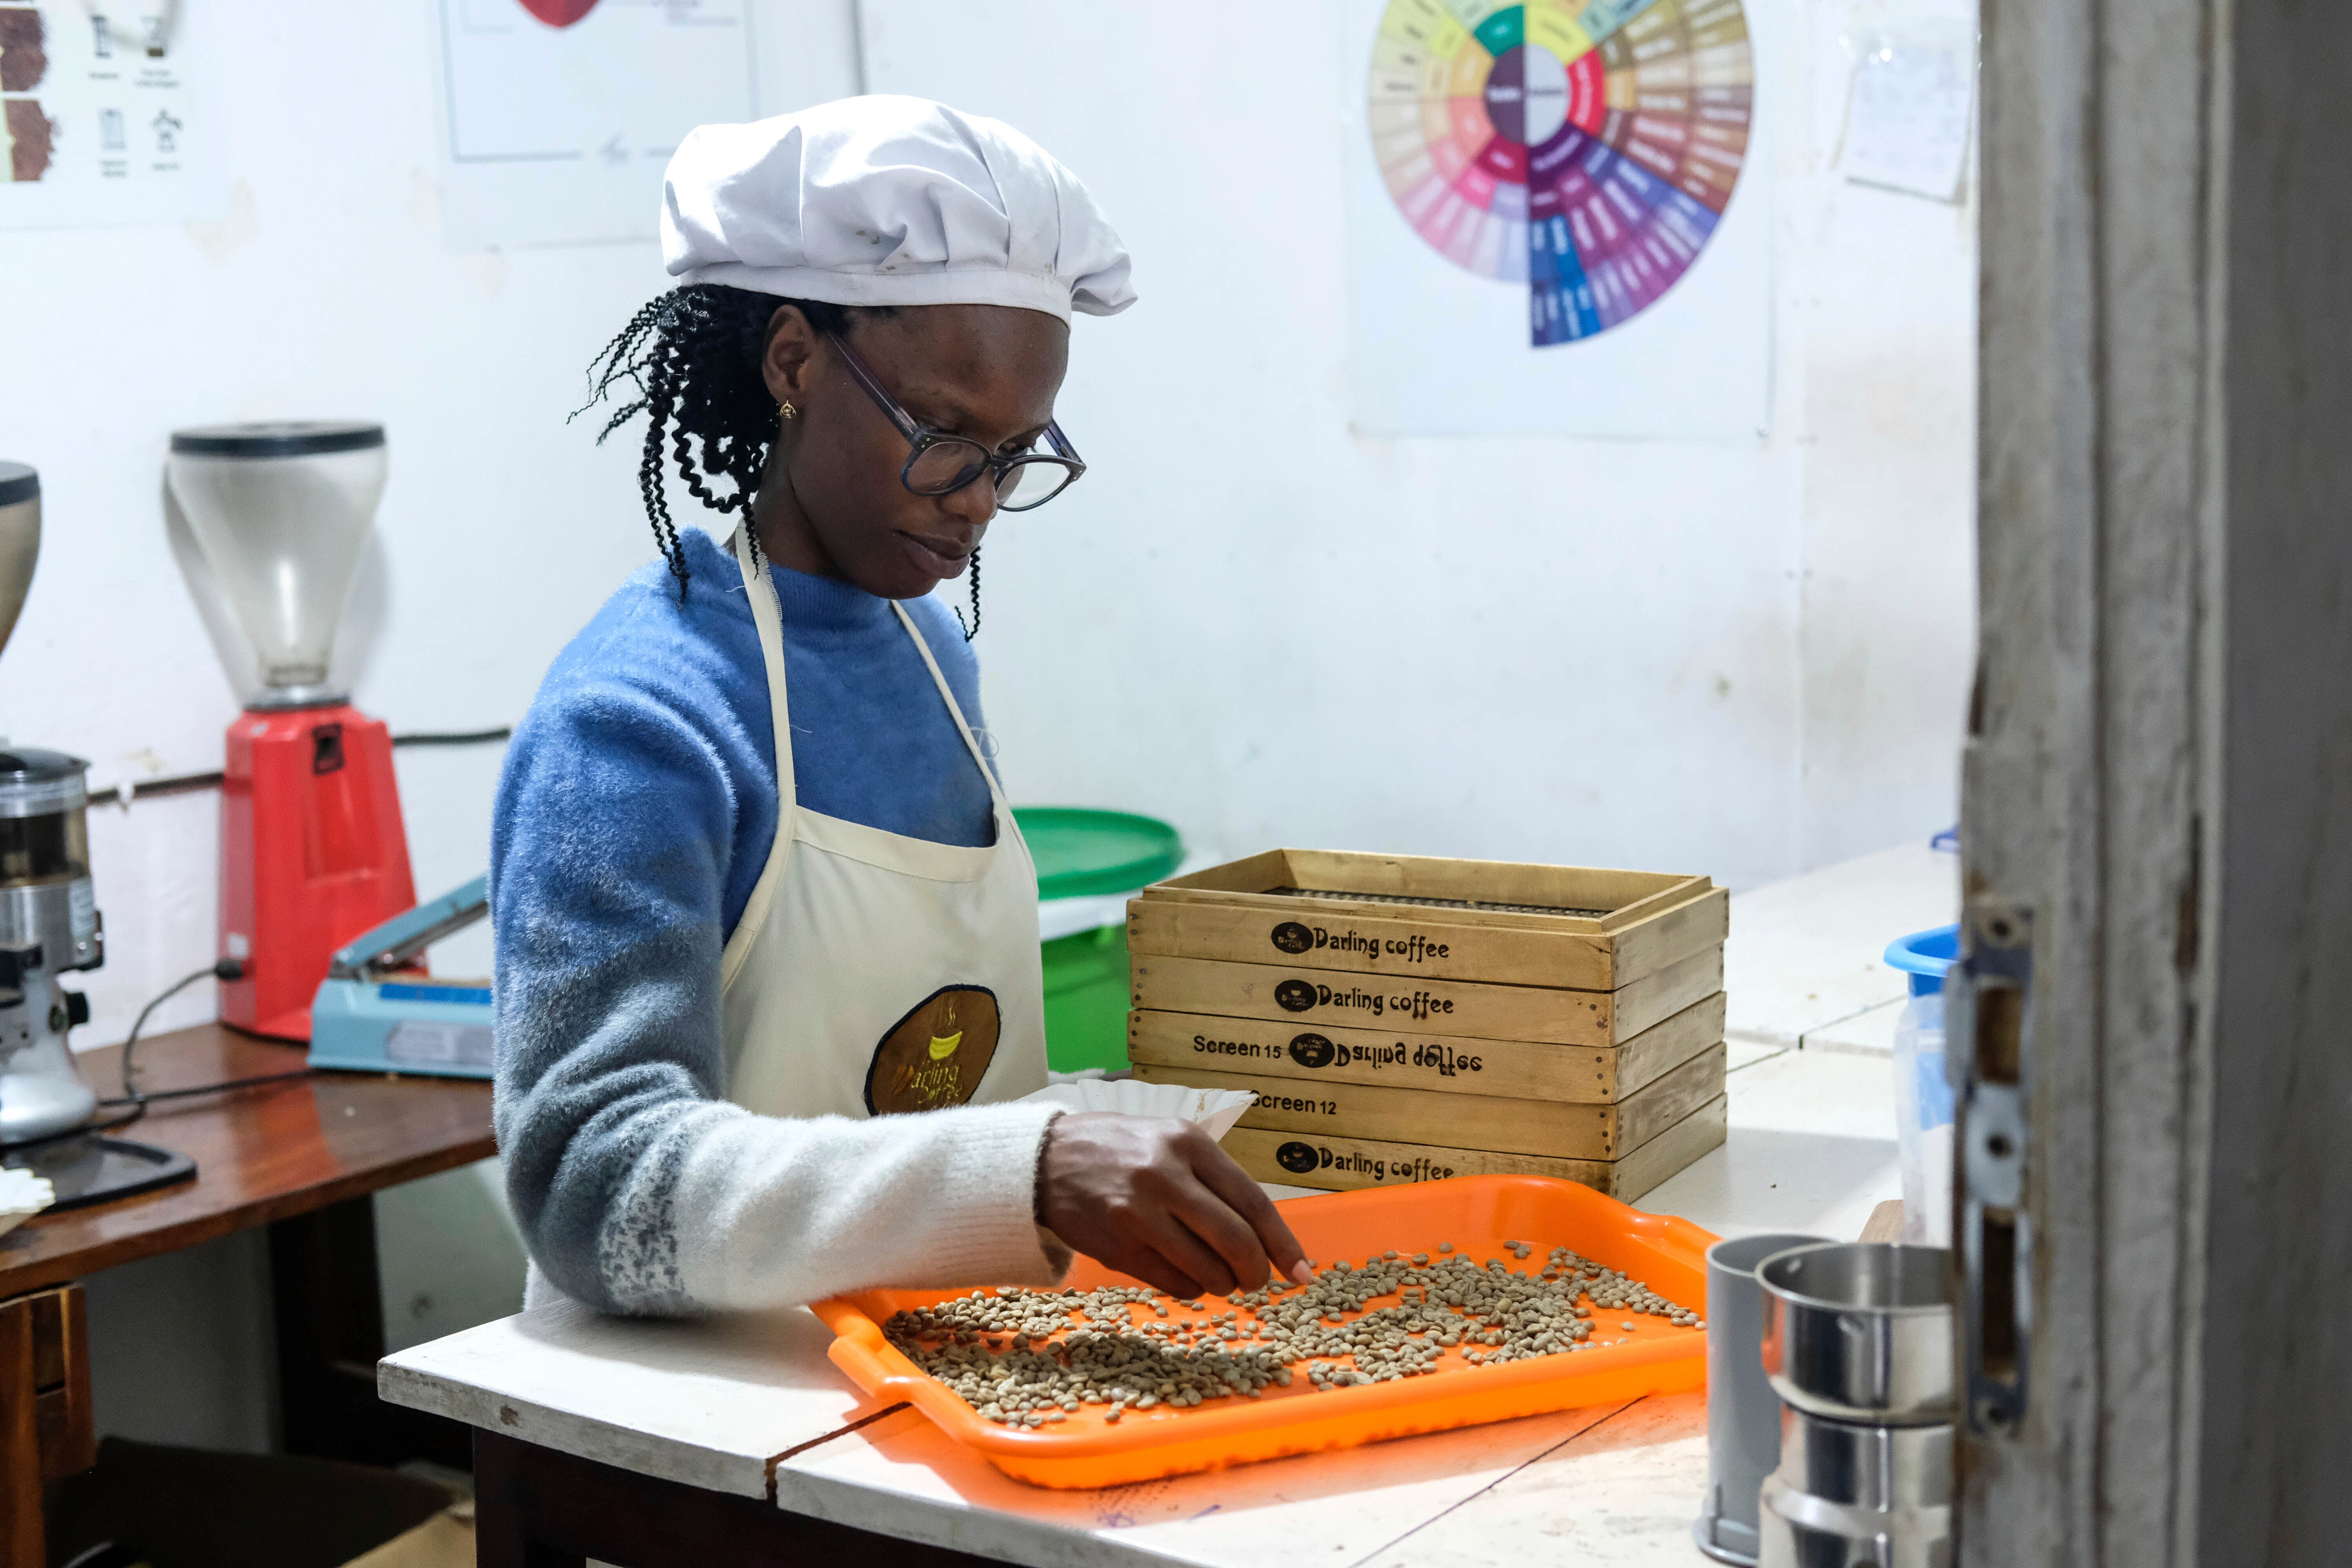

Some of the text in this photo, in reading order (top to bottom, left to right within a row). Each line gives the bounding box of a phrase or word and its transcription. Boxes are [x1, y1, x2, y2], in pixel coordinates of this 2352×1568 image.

[1313, 927, 1449, 963] Darling coffee
[1317, 985, 1454, 1019] Darling coffee
[1194, 1035, 1281, 1059] Screen 15
[1320, 1101, 1336, 1115] 12
[1318, 1147, 1385, 1180] Darling
[1391, 1158, 1454, 1183] coffee
